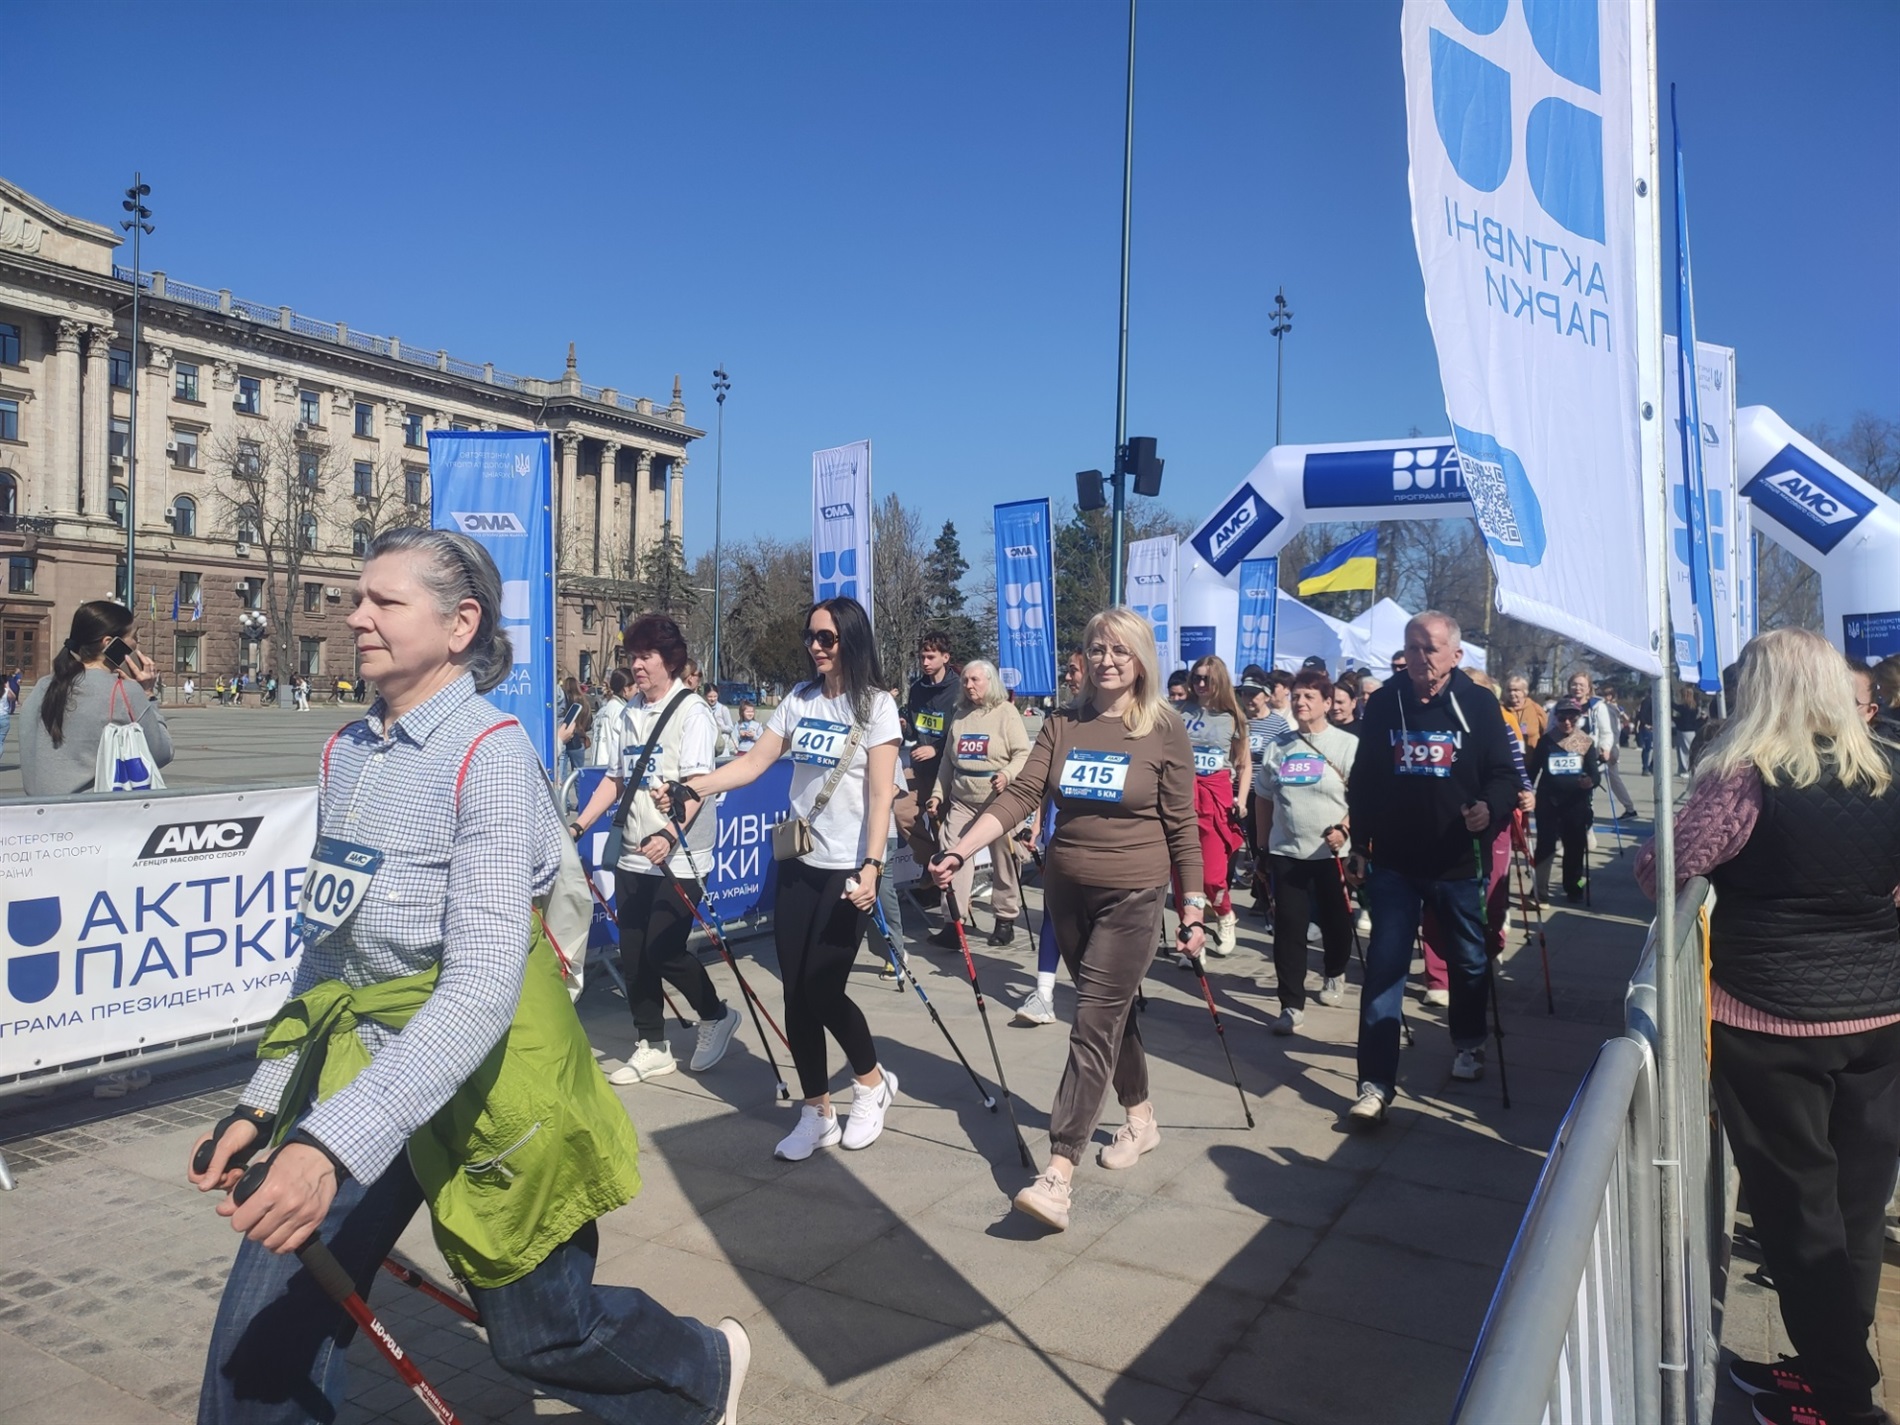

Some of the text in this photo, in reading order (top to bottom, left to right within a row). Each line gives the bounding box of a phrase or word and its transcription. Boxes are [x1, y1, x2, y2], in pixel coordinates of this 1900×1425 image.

[1393, 493, 1446, 502] ПРОГРАМА
[922, 716, 937, 728] 761
[797, 731, 835, 752] 401
[961, 741, 984, 752] 205
[1194, 755, 1217, 768] 416
[1401, 744, 1445, 763] 299
[628, 758, 657, 773] 48
[1287, 762, 1311, 773] 385
[1553, 759, 1576, 768] 425
[1070, 764, 1115, 785] 415
[1097, 789, 1103, 797] 5
[0, 844, 102, 864] ЛОДІ ТА СПОРТУ
[132, 850, 247, 868] АГЕНЦІЯ МАСОВОГО СПОРТУ
[712, 846, 759, 883] КИ
[304, 869, 355, 918] 409
[722, 883, 760, 900] УКРАЇНИ
[0, 1010, 84, 1039] ГРАМА
[91, 982, 235, 1021] ПРЕЗИДЕНТА
